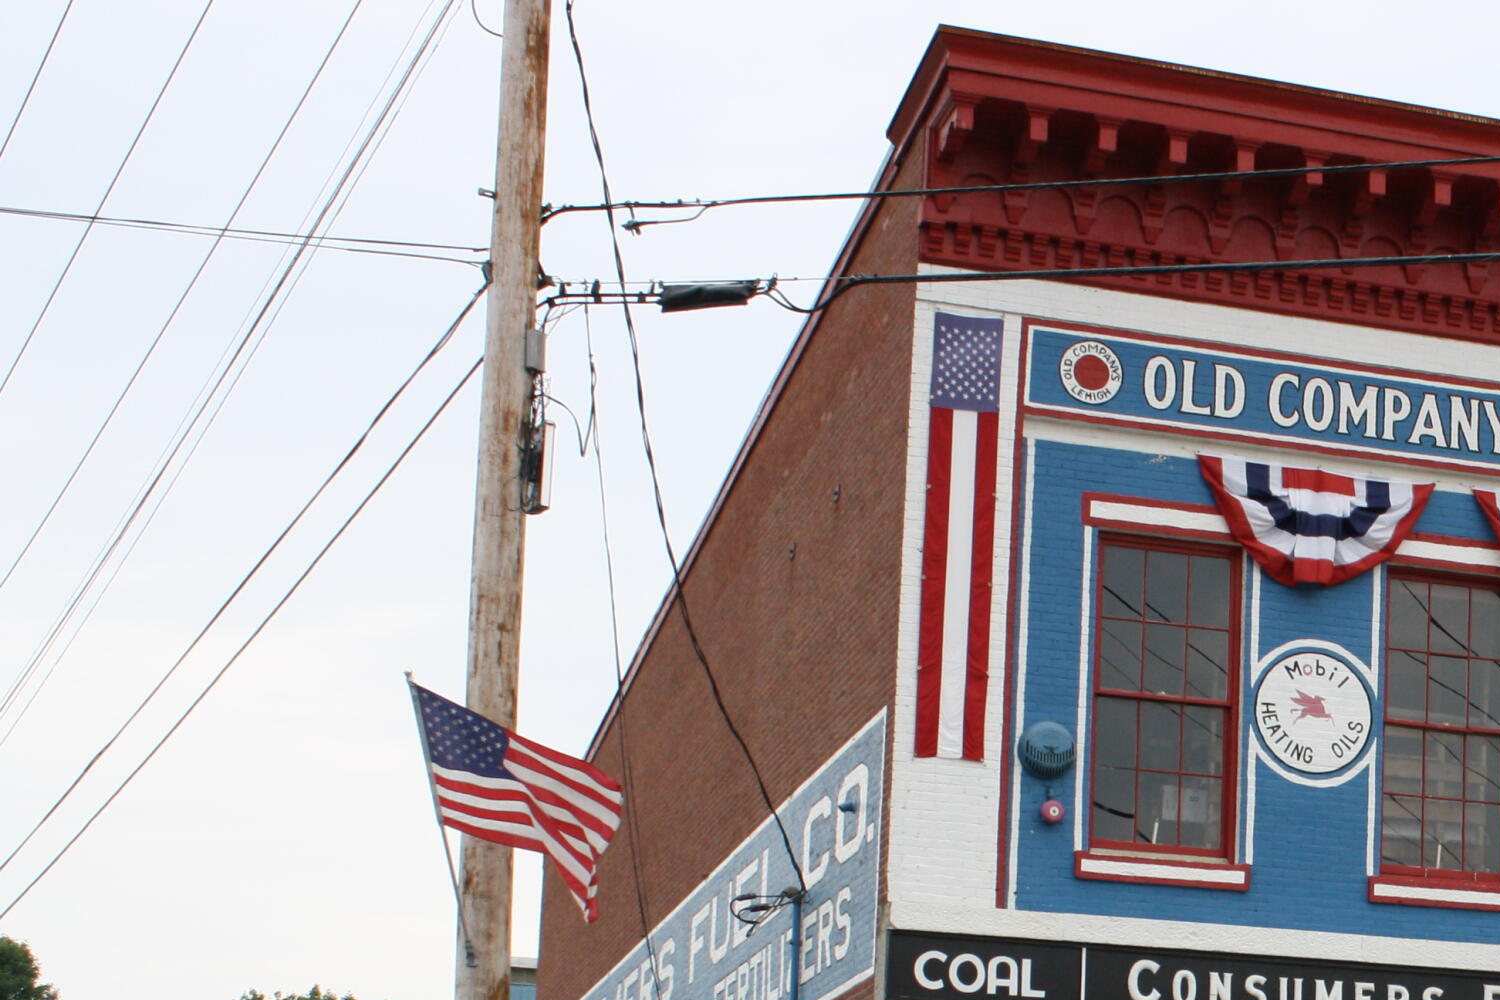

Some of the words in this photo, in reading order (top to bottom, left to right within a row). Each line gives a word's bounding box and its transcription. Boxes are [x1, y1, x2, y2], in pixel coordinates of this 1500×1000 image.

[1063, 359, 1073, 380] OLD
[1071, 385, 1112, 401] LEHIGH
[1144, 355, 1246, 419] OLD
[1284, 659, 1350, 689] Mobil
[1261, 702, 1314, 764] HEATING
[1331, 721, 1364, 758] OILS
[688, 848, 782, 985] FUEL
[914, 950, 1046, 998] COAL
